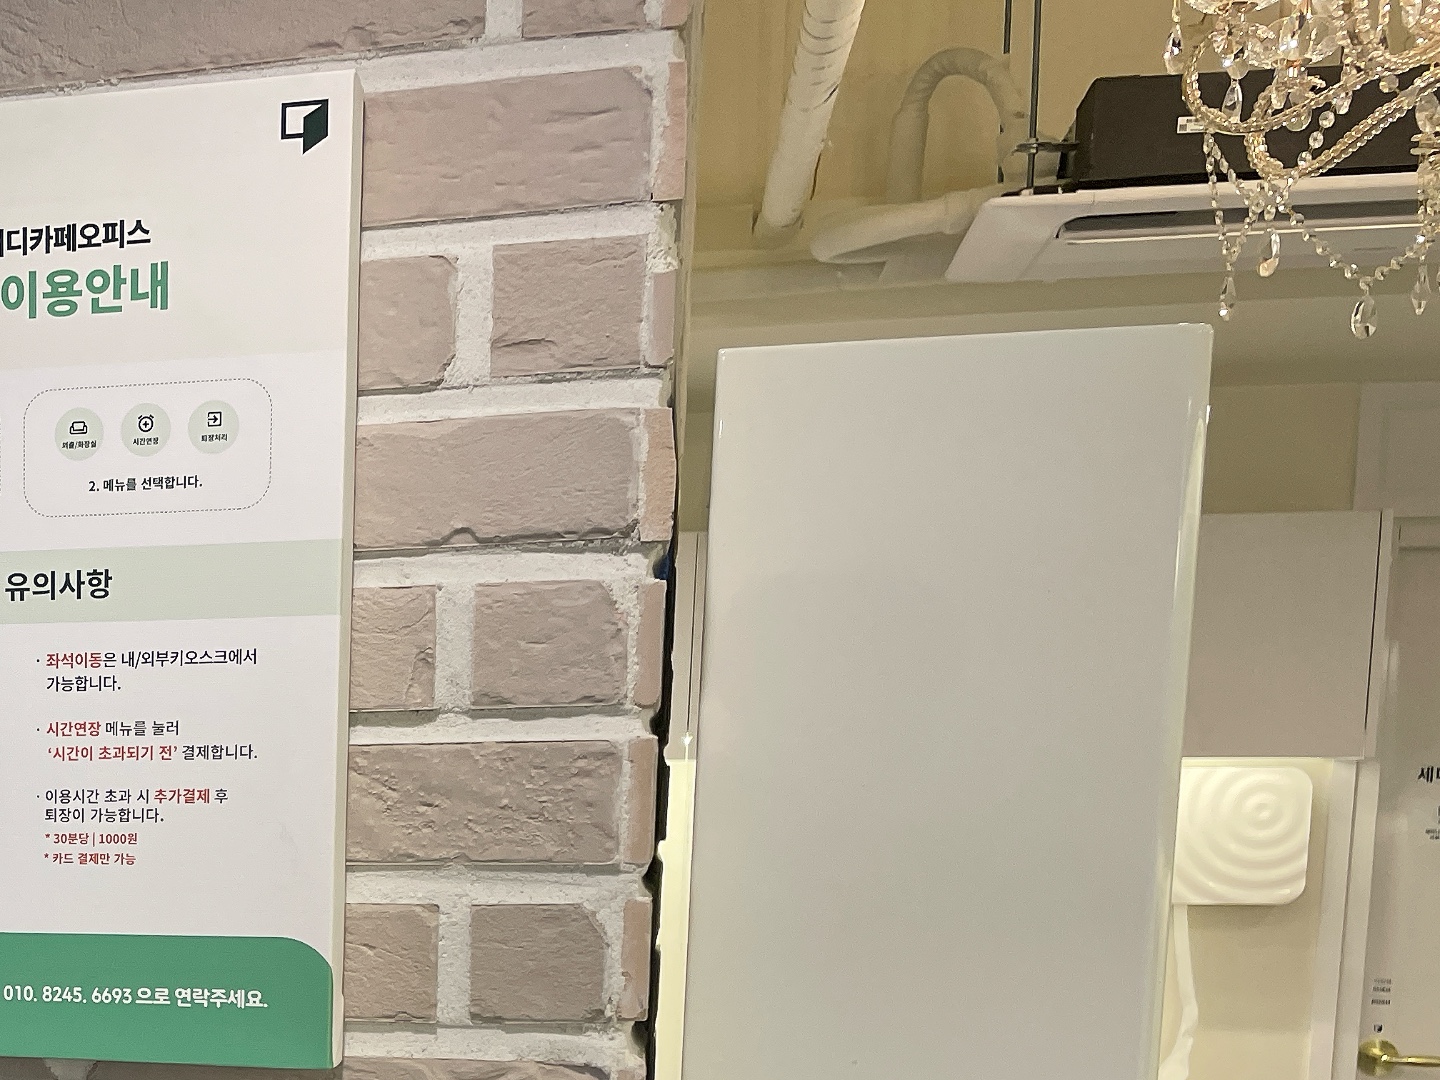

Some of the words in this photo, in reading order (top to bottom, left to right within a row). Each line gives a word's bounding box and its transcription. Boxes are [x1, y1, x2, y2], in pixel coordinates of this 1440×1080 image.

[1, 261, 168, 319] 이용안내
[89, 481, 99, 491] 2.
[104, 478, 136, 491] 메뉴를
[141, 475, 202, 490] 선택합니다.
[5, 569, 112, 601] 유의사항
[47, 652, 116, 669] 좌석이동은
[122, 649, 256, 669] 내/외부키오스크에서
[47, 675, 121, 692] 가능합니다.
[47, 722, 101, 736] 시간연장
[106, 721, 146, 736] 메뉴를
[152, 721, 178, 735] 눌러
[99, 746, 153, 761] 초과되기
[182, 744, 257, 760] 결제합니다.
[46, 789, 99, 804] 이용시간
[105, 789, 131, 804] 초과
[137, 789, 149, 804] 시
[154, 789, 209, 804] 추가결제
[215, 789, 228, 803] 후
[45, 808, 84, 823] 퇴장이
[91, 808, 163, 823] 가능합니다.
[54, 833, 89, 844] 30분당
[99, 833, 137, 844] 1000원
[53, 853, 73, 864] 카드
[78, 853, 110, 864] 결제만
[114, 853, 136, 865] 가능
[4, 984, 37, 1002] 010.
[42, 985, 87, 1004] 8245.
[91, 987, 132, 1004] 6693
[136, 987, 170, 1005] 으로
[174, 987, 268, 1008] 연락주세요.
